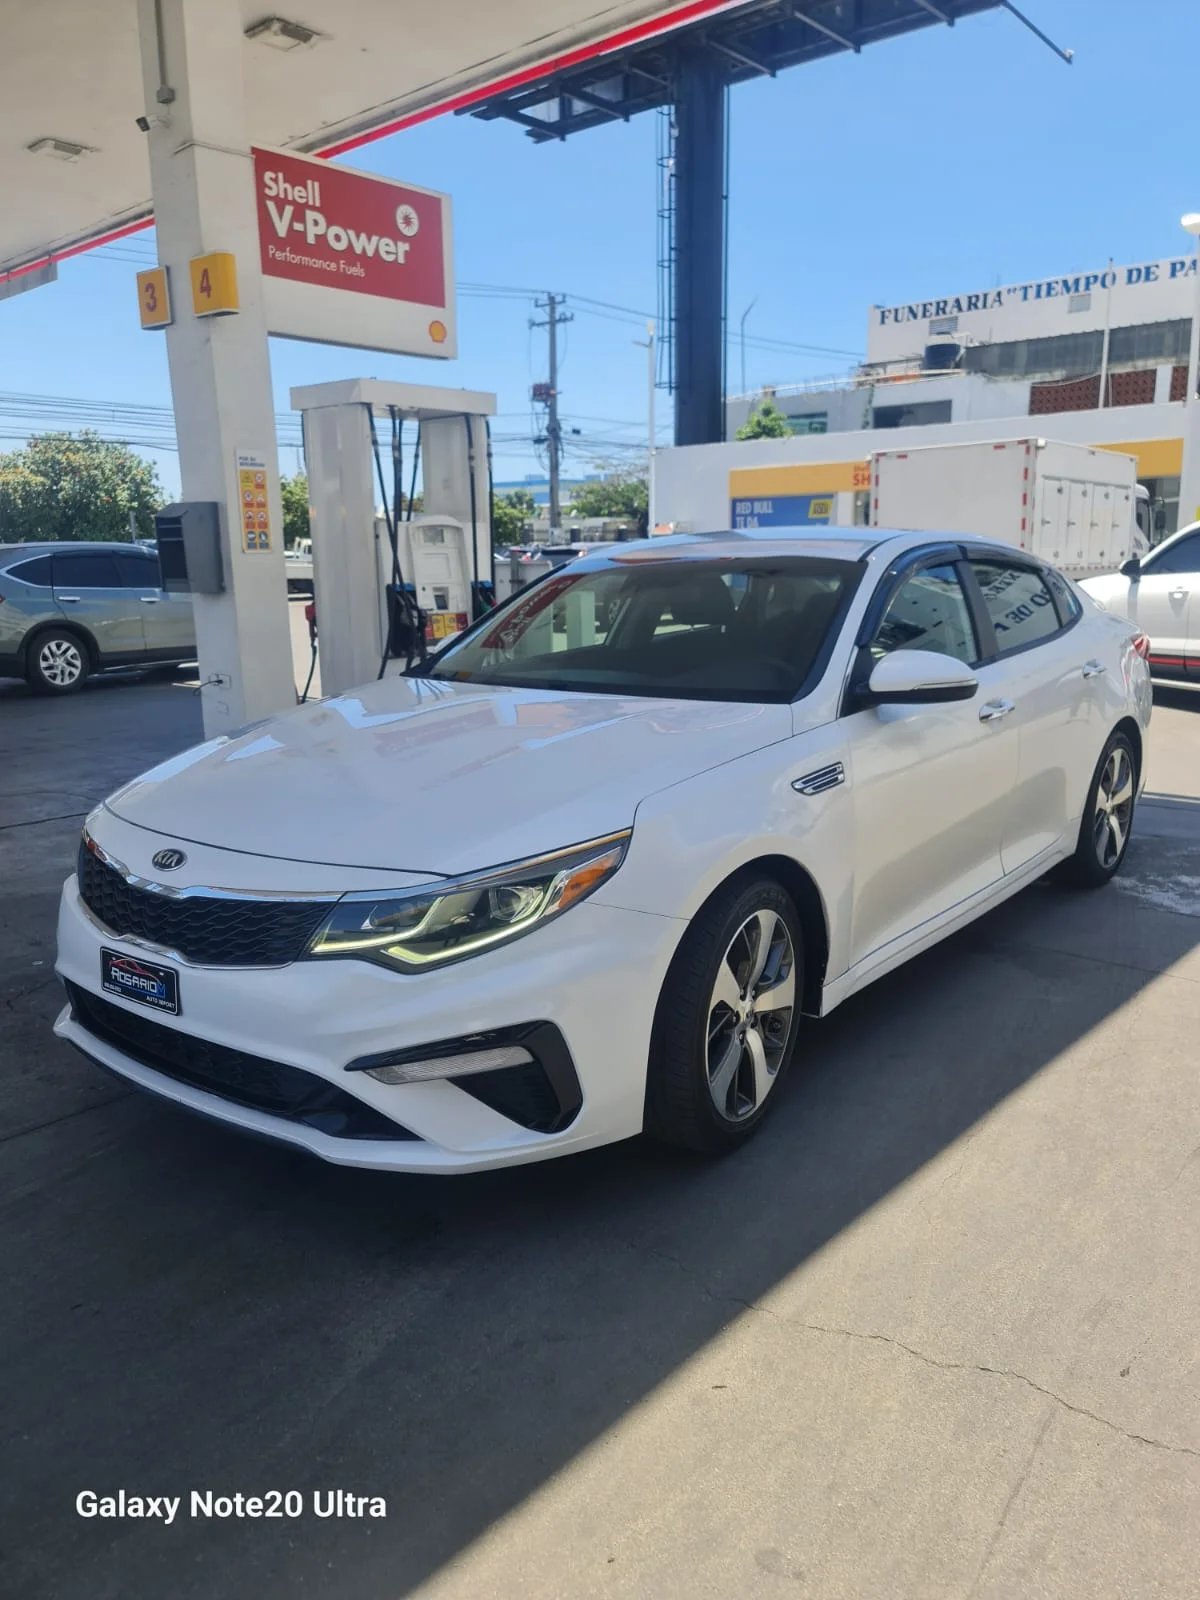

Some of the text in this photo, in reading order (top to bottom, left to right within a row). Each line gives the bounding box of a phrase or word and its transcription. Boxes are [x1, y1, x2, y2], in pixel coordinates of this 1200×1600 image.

[264, 171, 321, 207] Shell
[266, 200, 410, 265] V-Power
[268, 245, 366, 278] Performance Fuels
[144, 282, 158, 313] 3
[199, 267, 212, 299] 4
[879, 289, 1004, 326] FUNERARIA
[1126, 264, 1160, 285] DE
[736, 502, 752, 515] RED
[154, 851, 181, 867] KIA
